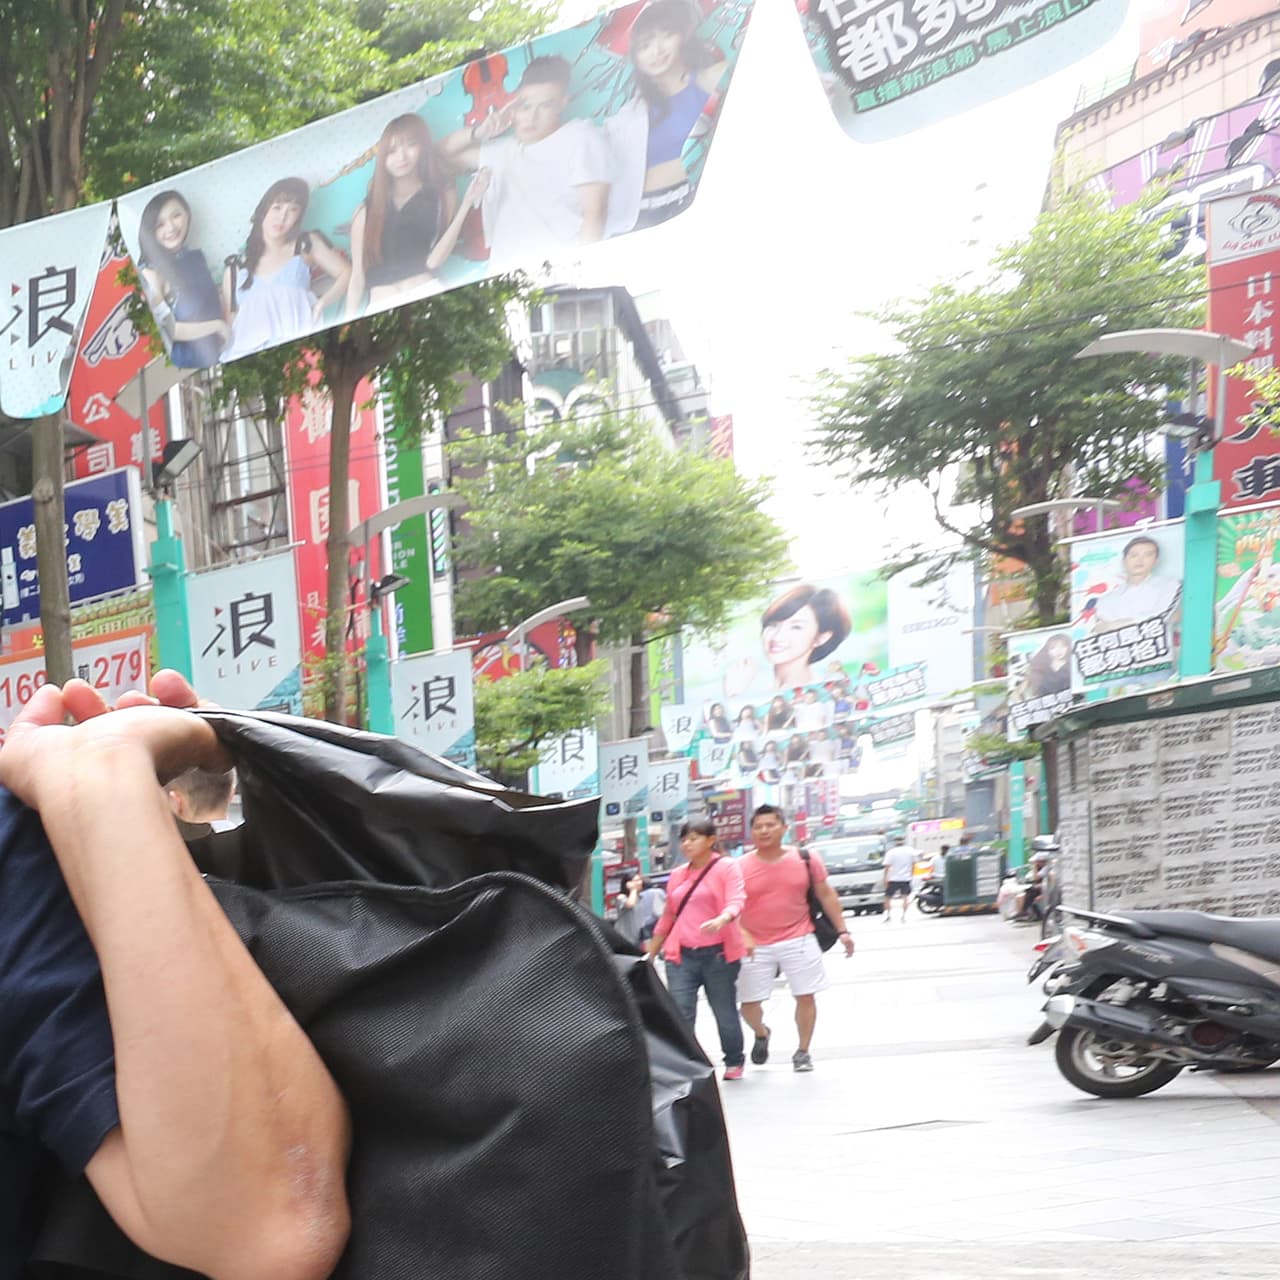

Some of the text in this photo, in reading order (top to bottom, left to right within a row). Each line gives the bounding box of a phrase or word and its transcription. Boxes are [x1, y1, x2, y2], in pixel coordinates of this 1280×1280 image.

[202, 592, 276, 659] 浪
[93, 650, 143, 690] 279
[218, 656, 278, 679] LIVE
[401, 675, 457, 722] 浪
[605, 754, 639, 781] 浪
